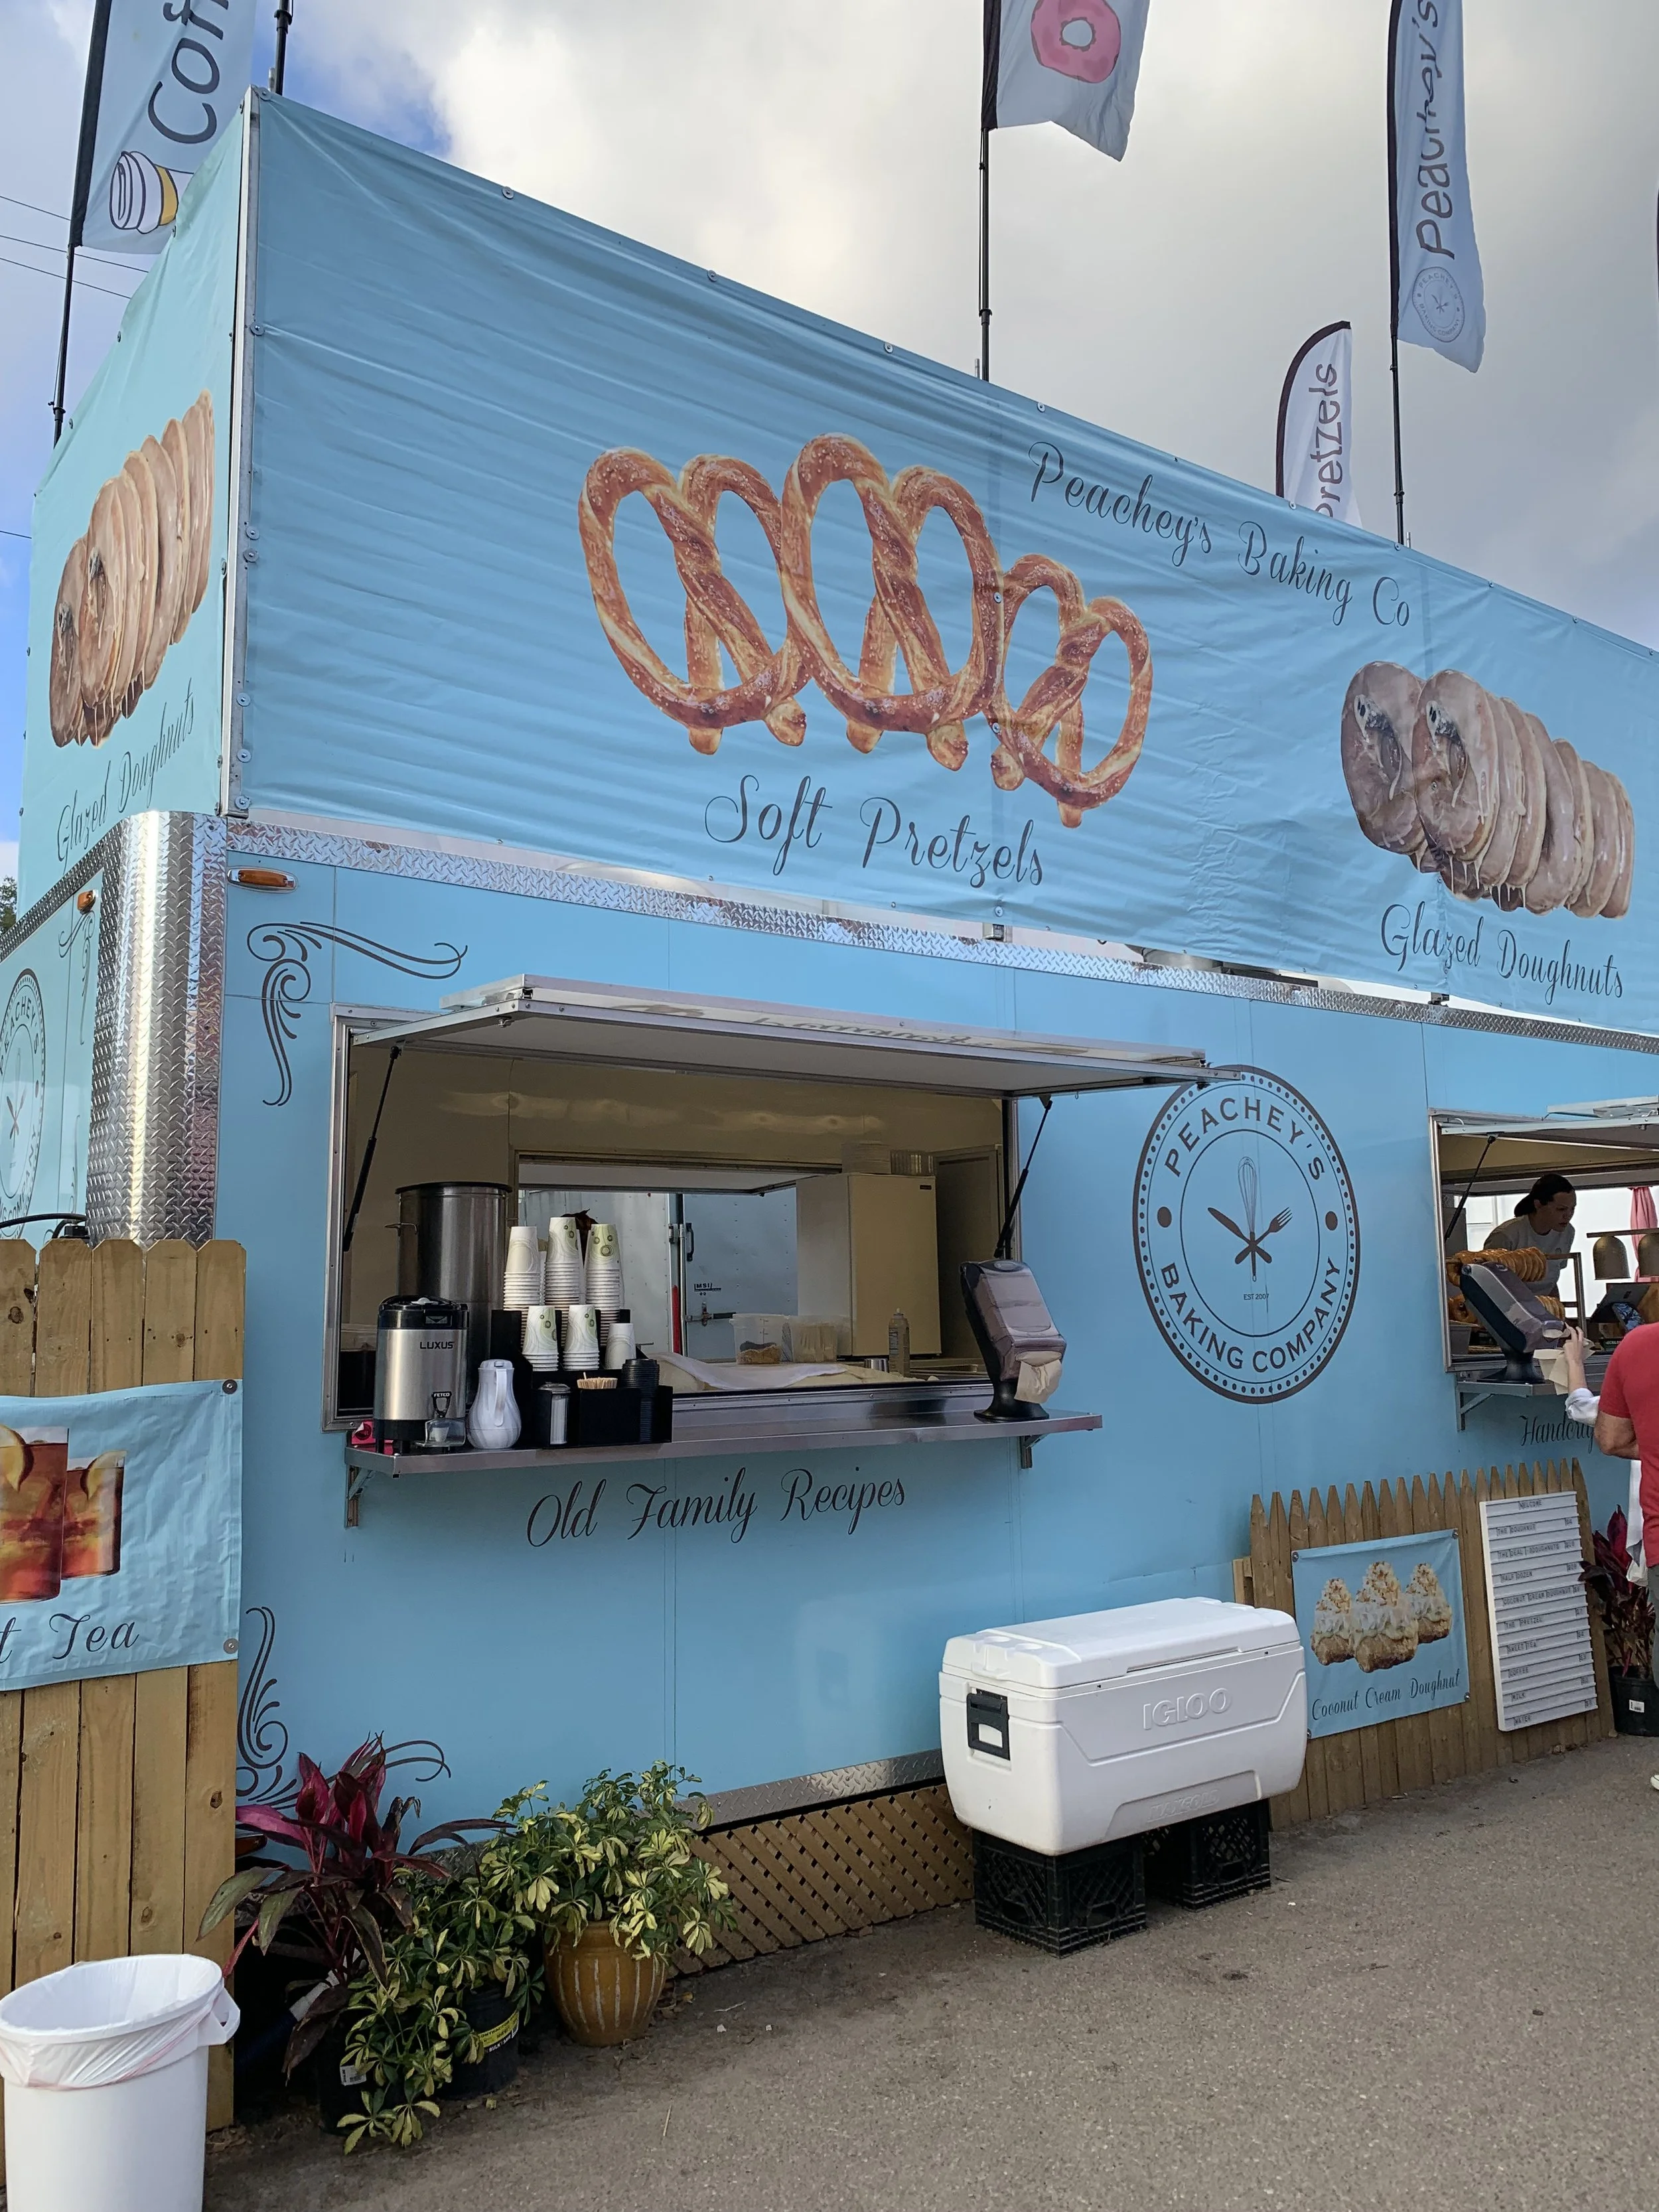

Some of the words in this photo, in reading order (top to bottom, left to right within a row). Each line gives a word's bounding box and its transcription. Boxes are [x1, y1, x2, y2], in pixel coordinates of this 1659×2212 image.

[148, 0, 229, 144] Cof
[1028, 441, 1212, 567] Peachey's
[1238, 521, 1352, 626] Baking
[1372, 576, 1410, 627] Co
[57, 759, 111, 875] Glazed
[117, 677, 194, 814] Doughnuts
[704, 774, 833, 876] Soft
[859, 796, 1043, 889] Pretzels
[1381, 901, 1484, 972] Glazed
[1496, 929, 1624, 1005] Doughnuts
[1165, 1096, 1326, 1180] PEACHEY'S
[1160, 1262, 1244, 1370] BAKING
[1253, 1257, 1340, 1373] COMPANY
[526, 1478, 607, 1547] Old
[626, 1467, 758, 1543] Family
[780, 1467, 905, 1535] Recipes
[1519, 1500, 1542, 1509] WELCOME
[49, 1613, 140, 1659] Tea
[1143, 1688, 1232, 1731] IGLOO
[1312, 1690, 1360, 1720] Coconut
[1365, 1687, 1402, 1708] Cream
[1409, 1668, 1461, 1700] Doughnut
